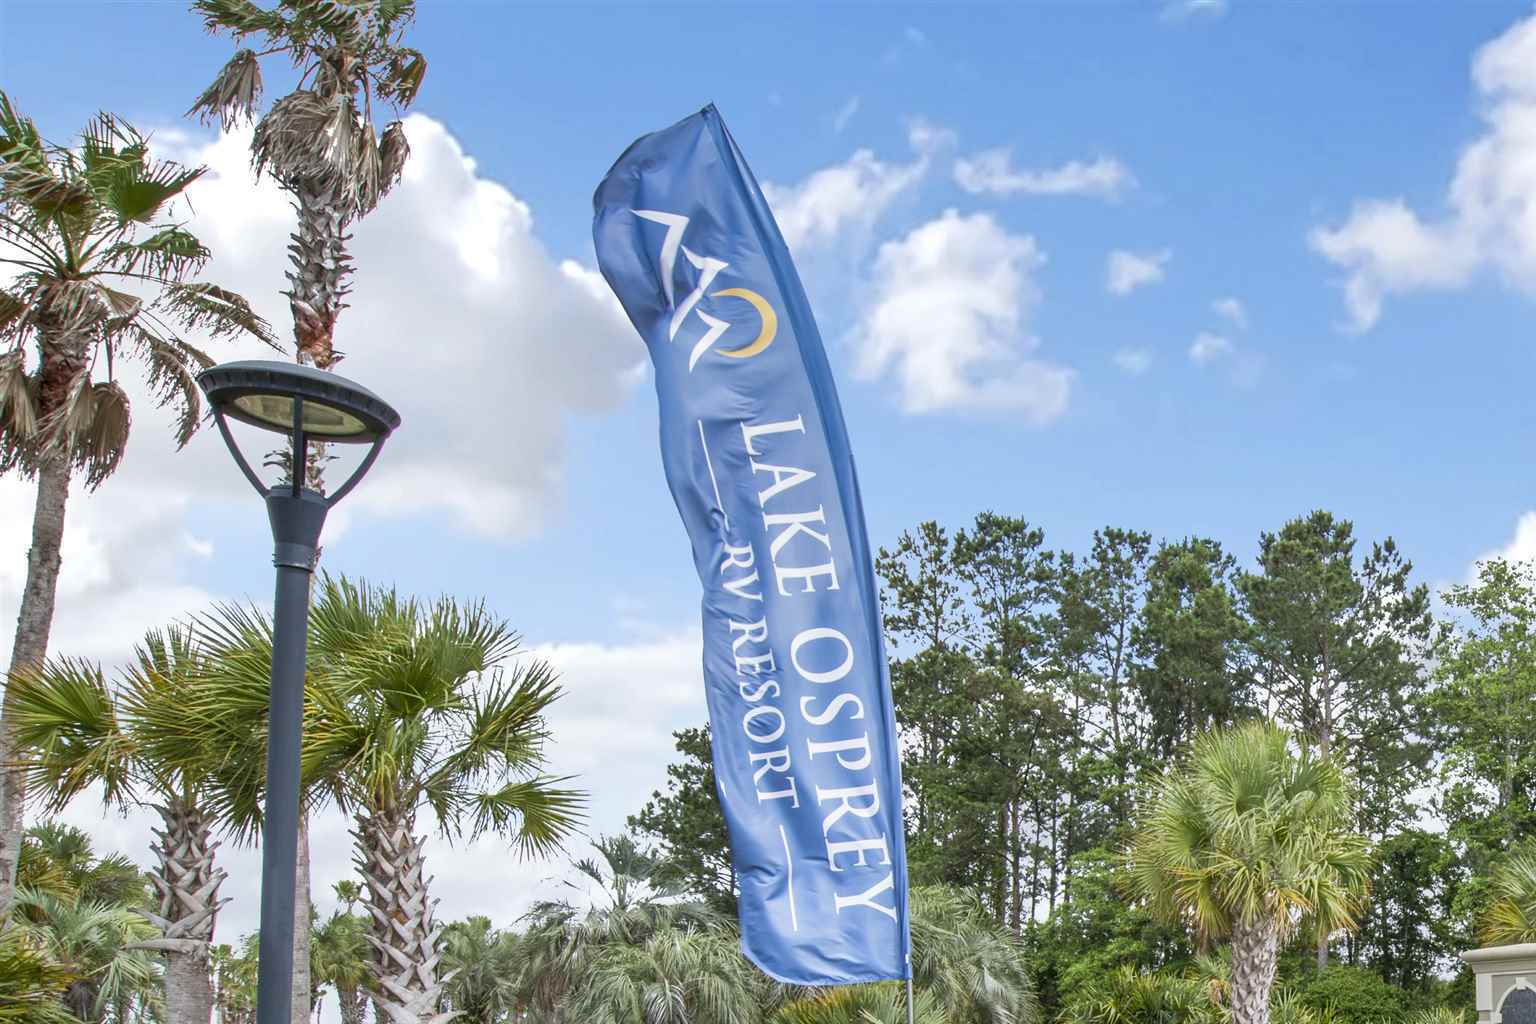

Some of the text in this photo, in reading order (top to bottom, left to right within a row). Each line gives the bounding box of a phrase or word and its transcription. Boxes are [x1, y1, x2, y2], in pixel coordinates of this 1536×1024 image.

[720, 541, 800, 809] RV RESORT
[740, 414, 898, 923] LAKE OSPREY
